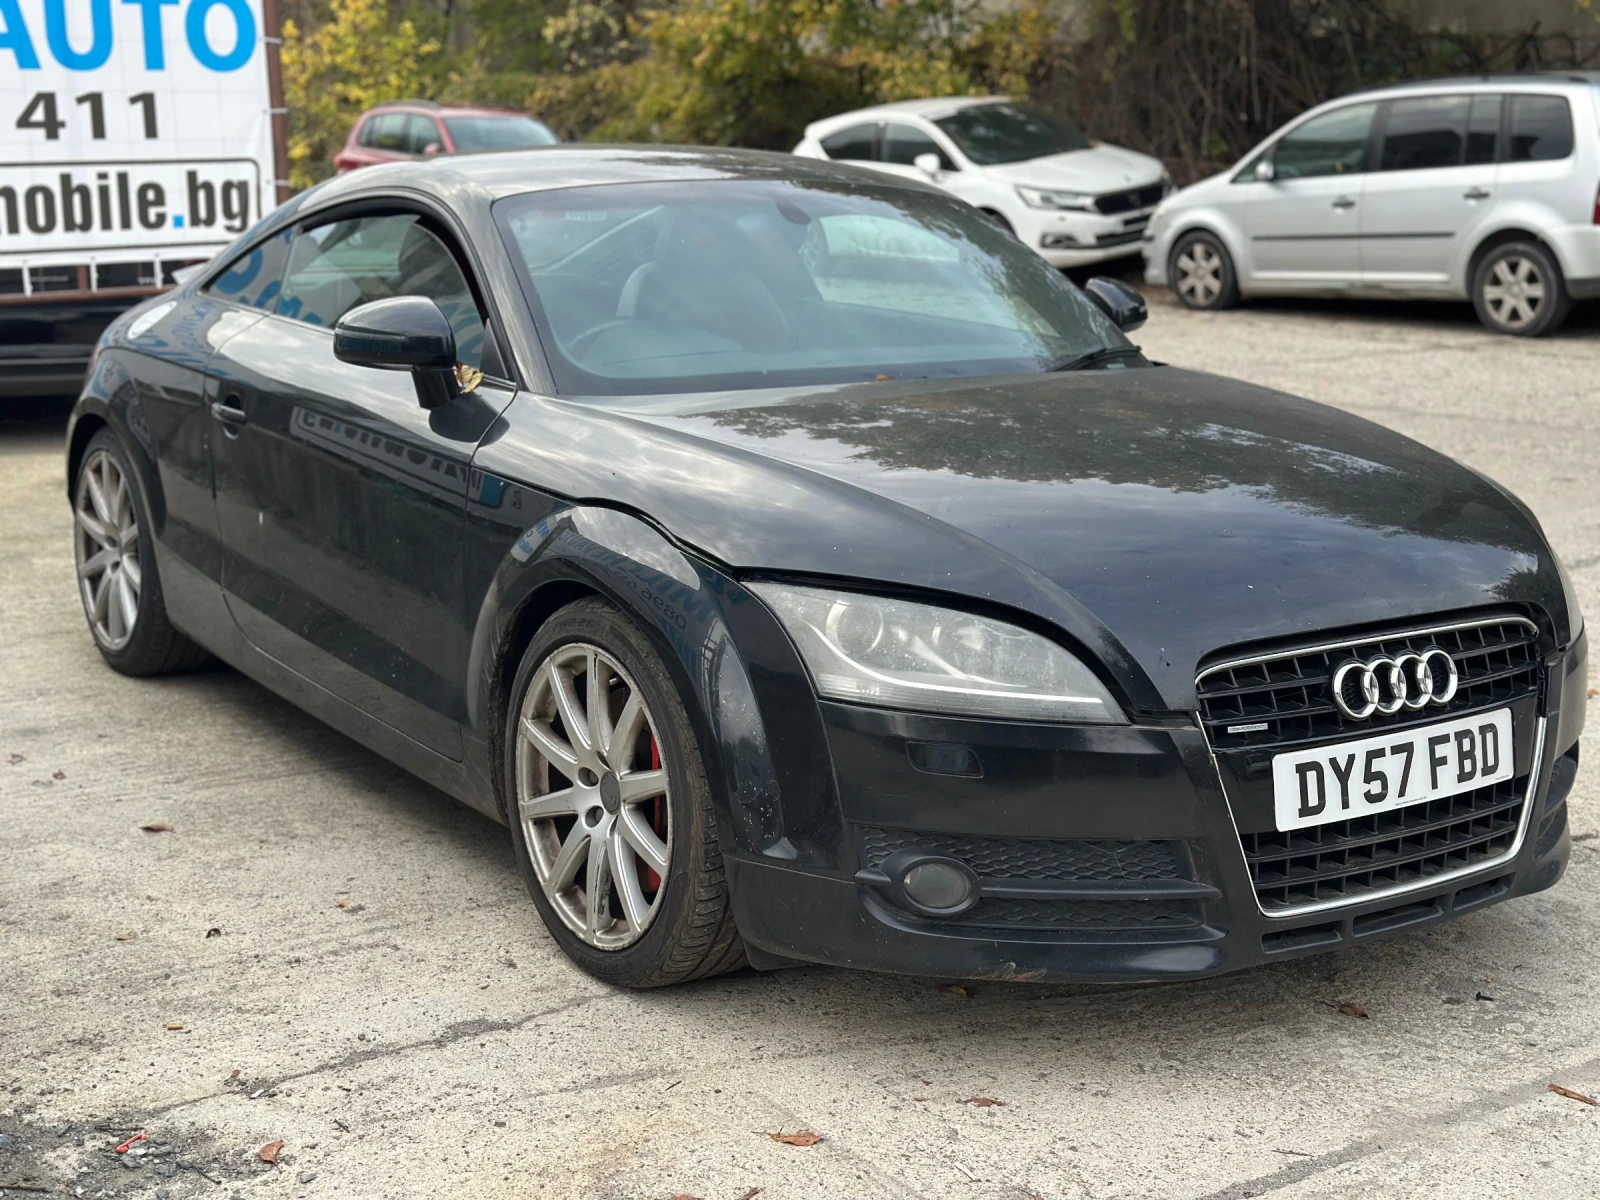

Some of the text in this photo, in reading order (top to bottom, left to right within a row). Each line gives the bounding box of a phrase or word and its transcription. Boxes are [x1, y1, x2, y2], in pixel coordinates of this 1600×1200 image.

[15, 92, 158, 140] 411
[1295, 722, 1500, 818] DY57 FBD
